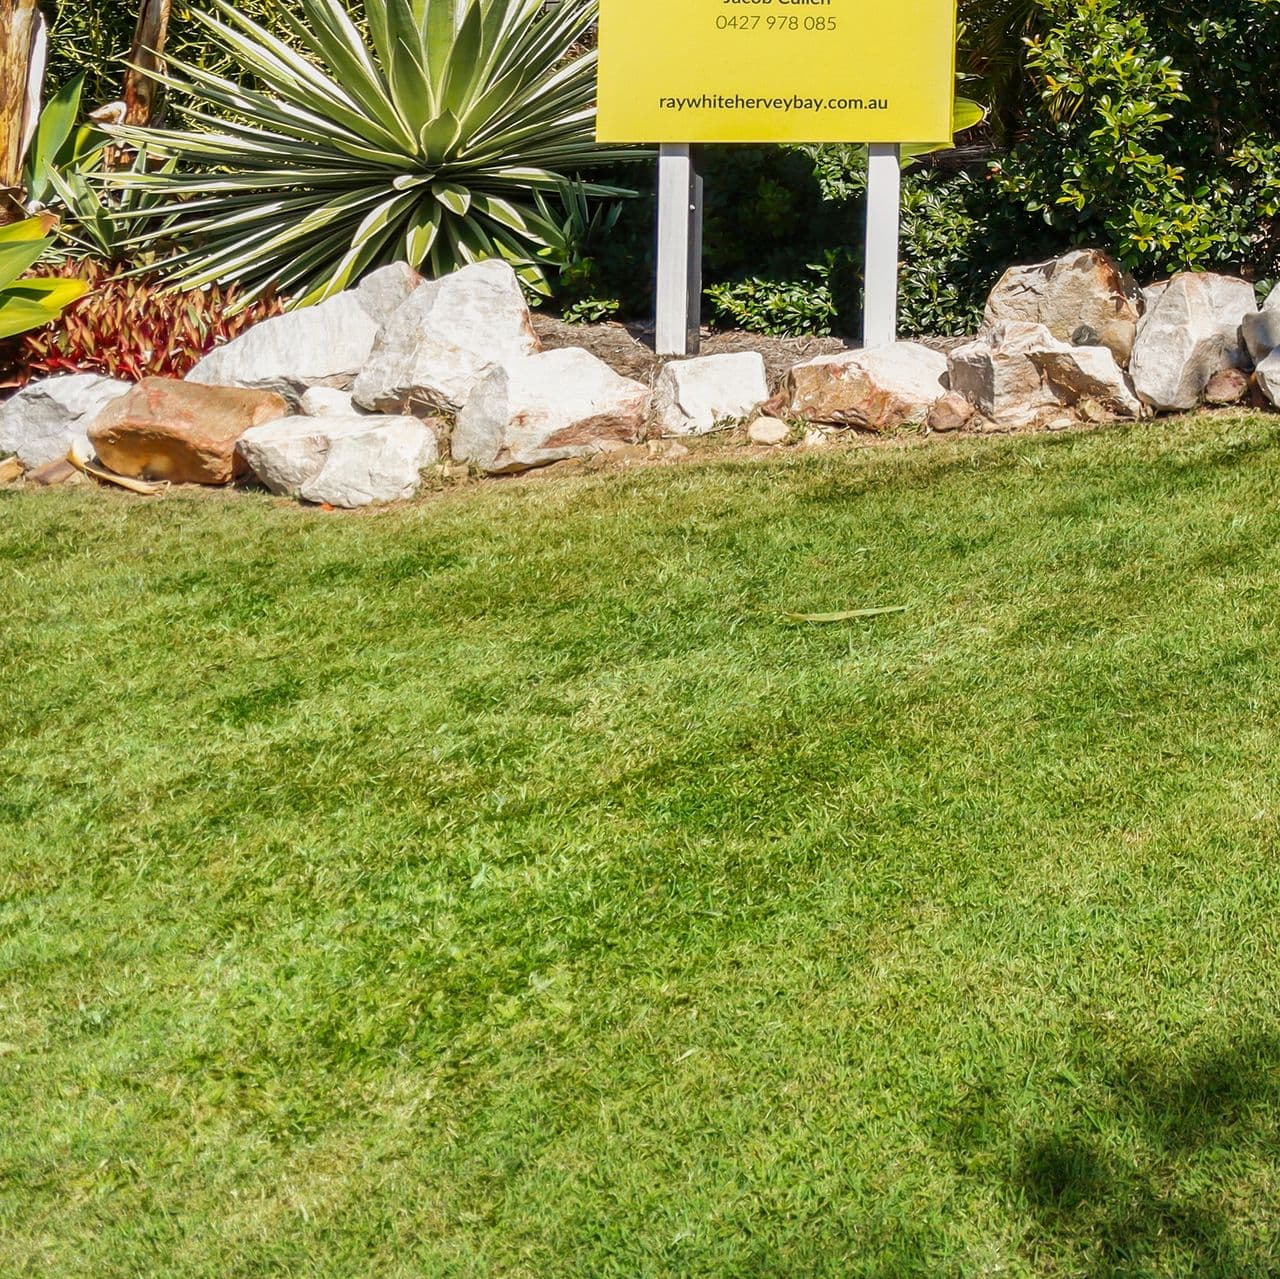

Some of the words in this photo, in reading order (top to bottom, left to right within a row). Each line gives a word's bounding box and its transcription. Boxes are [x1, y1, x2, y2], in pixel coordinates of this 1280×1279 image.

[715, 15, 761, 30] 0427
[765, 15, 799, 31] 978
[803, 16, 837, 32] 085
[659, 94, 888, 113] raywhiteherveybay.com.au
